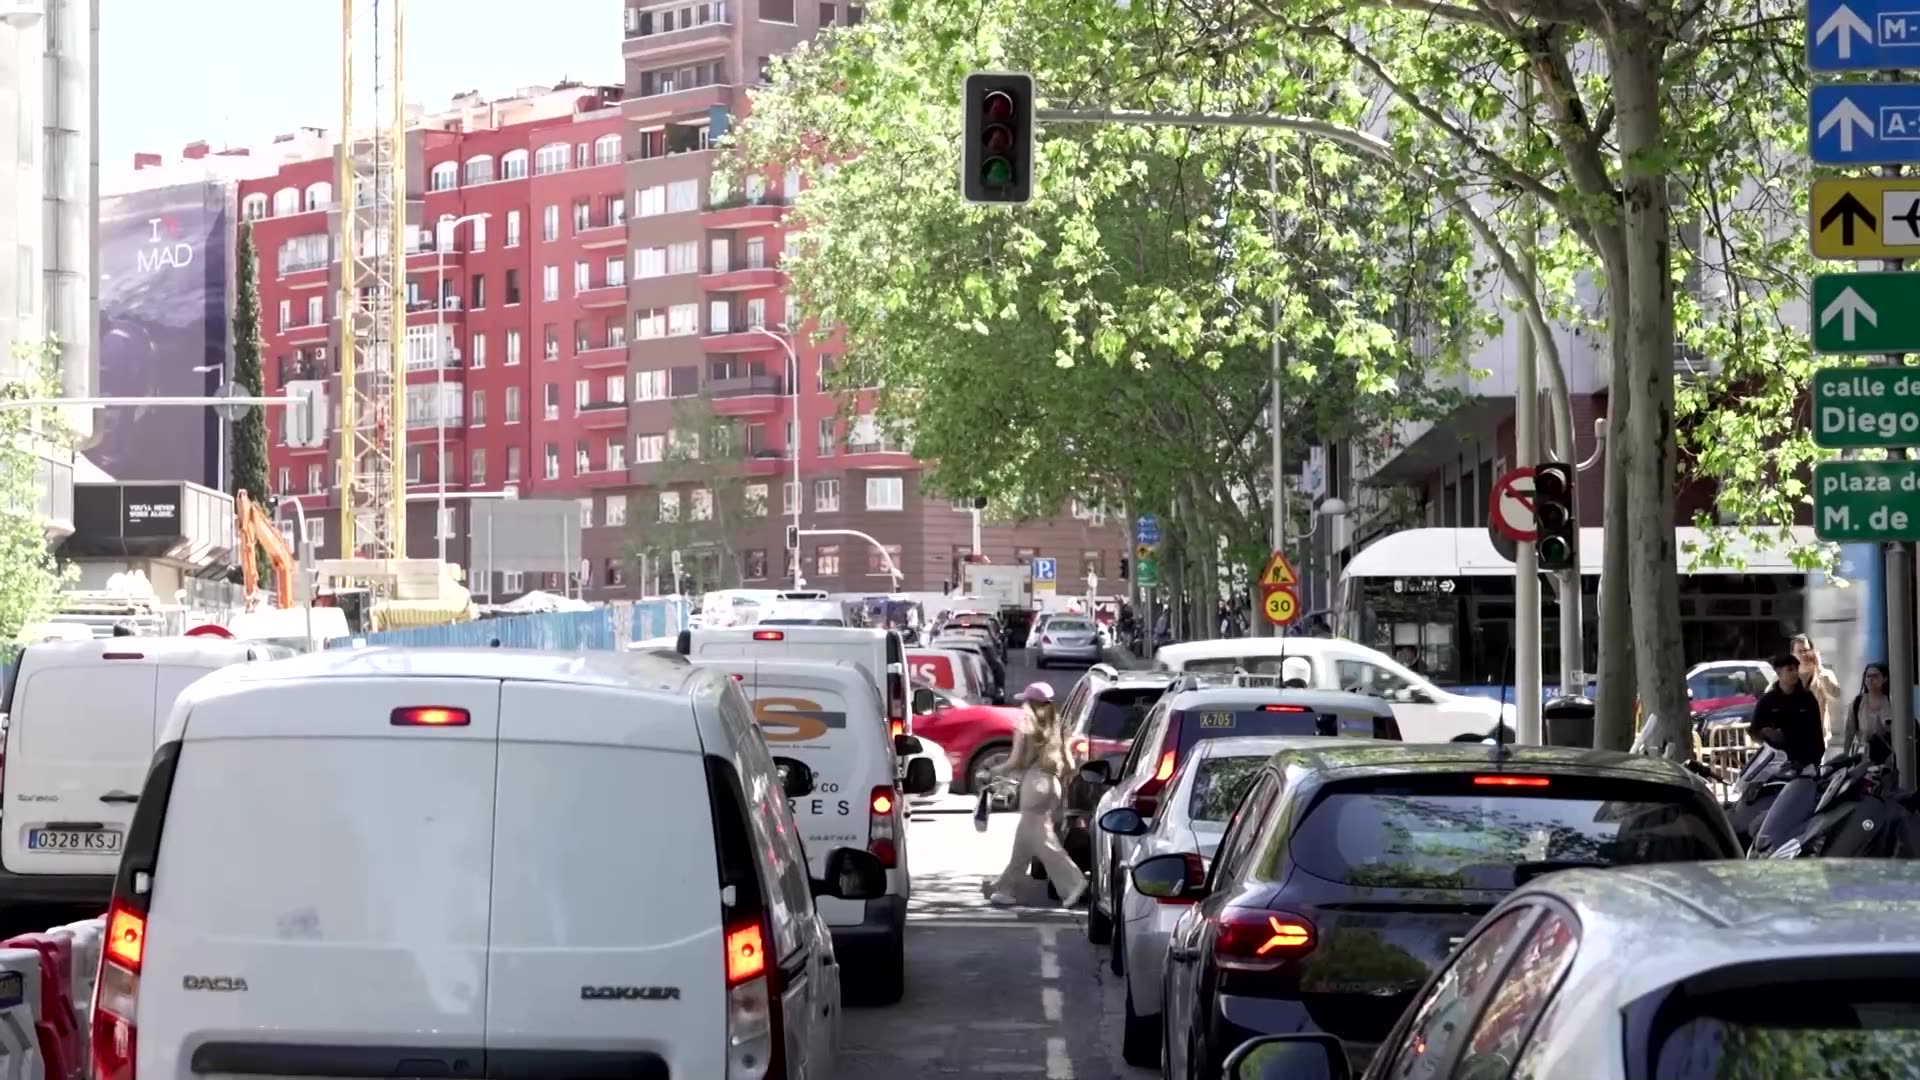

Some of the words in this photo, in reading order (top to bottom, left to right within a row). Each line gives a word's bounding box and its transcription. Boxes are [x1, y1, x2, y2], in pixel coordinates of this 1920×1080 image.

[1887, 112, 1920, 134] A-
[149, 217, 162, 242] I
[137, 243, 193, 272] MAD
[1822, 376, 1885, 397] calle
[1894, 376, 1920, 396] de
[1822, 406, 1919, 438] Diego
[1823, 471, 1891, 495] plaza
[1900, 471, 1920, 491] d
[1823, 505, 1859, 530] M.
[1868, 505, 1909, 530] de
[1270, 600, 1291, 613] 30
[1201, 712, 1231, 727] X-705
[38, 833, 79, 848] 0328
[85, 833, 116, 849] KSJ
[183, 975, 249, 992] DACIA
[581, 986, 680, 1000] DOKKER
